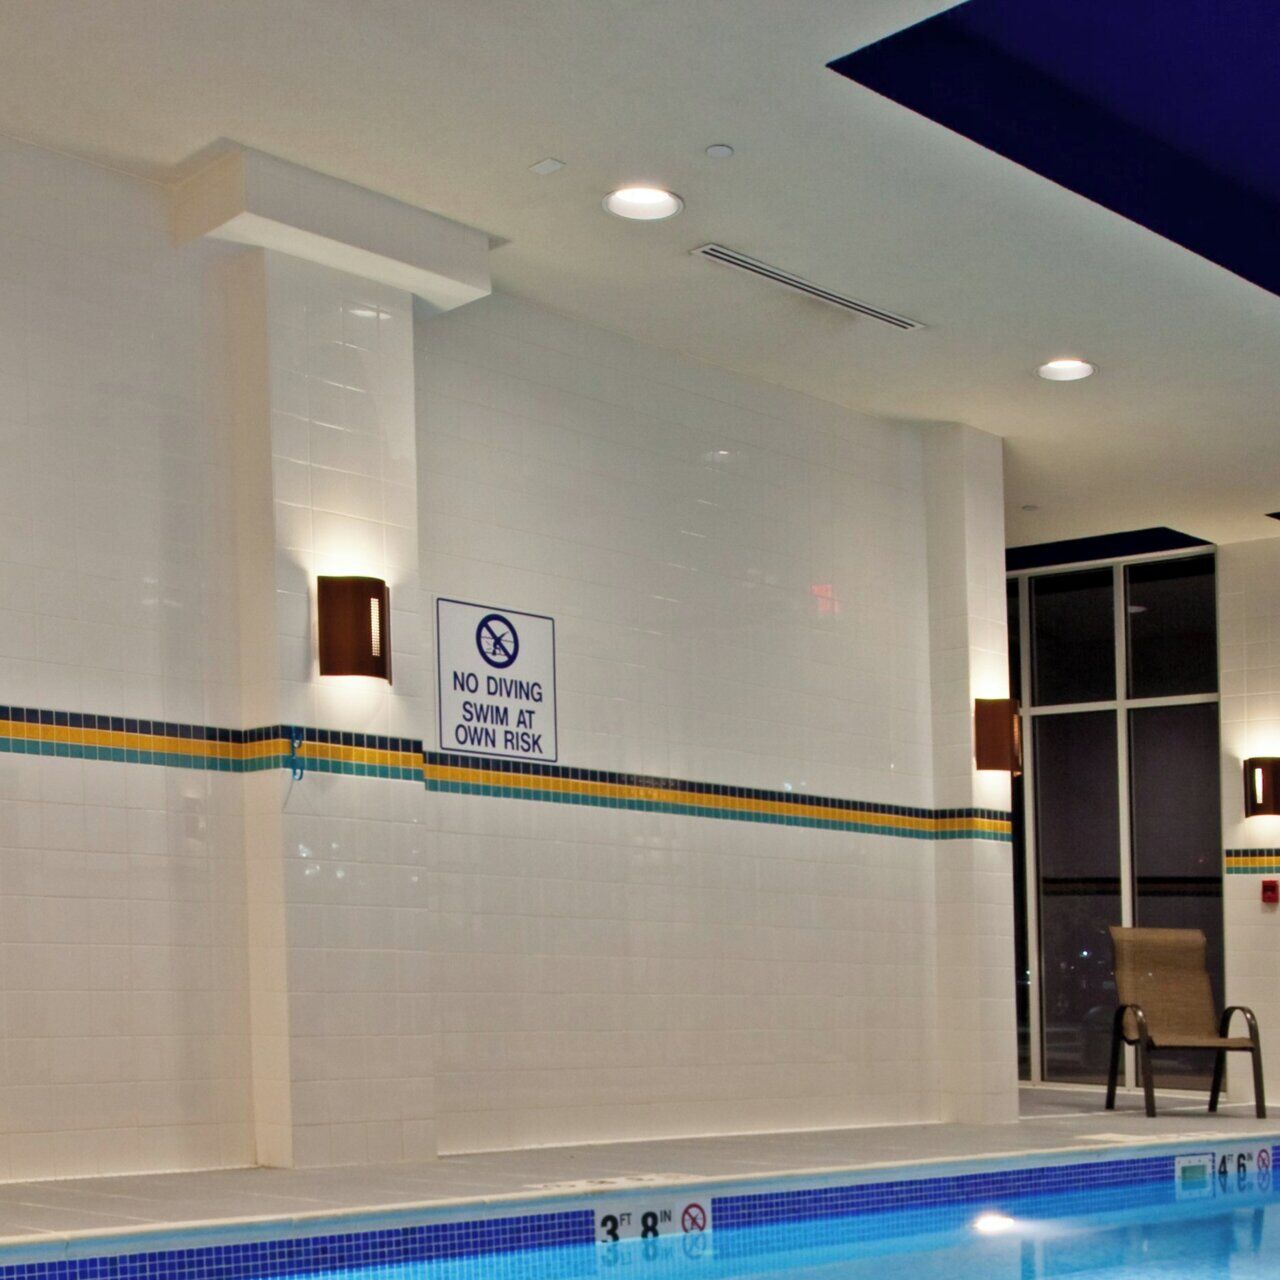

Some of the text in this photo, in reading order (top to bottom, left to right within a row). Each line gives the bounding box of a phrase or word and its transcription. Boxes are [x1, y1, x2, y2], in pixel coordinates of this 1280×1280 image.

[453, 671, 543, 703] NO DIVING
[462, 701, 536, 730] SWIM AT
[455, 724, 543, 754] OWN RISK
[601, 1210, 672, 1243] 3 FT 8 IN
